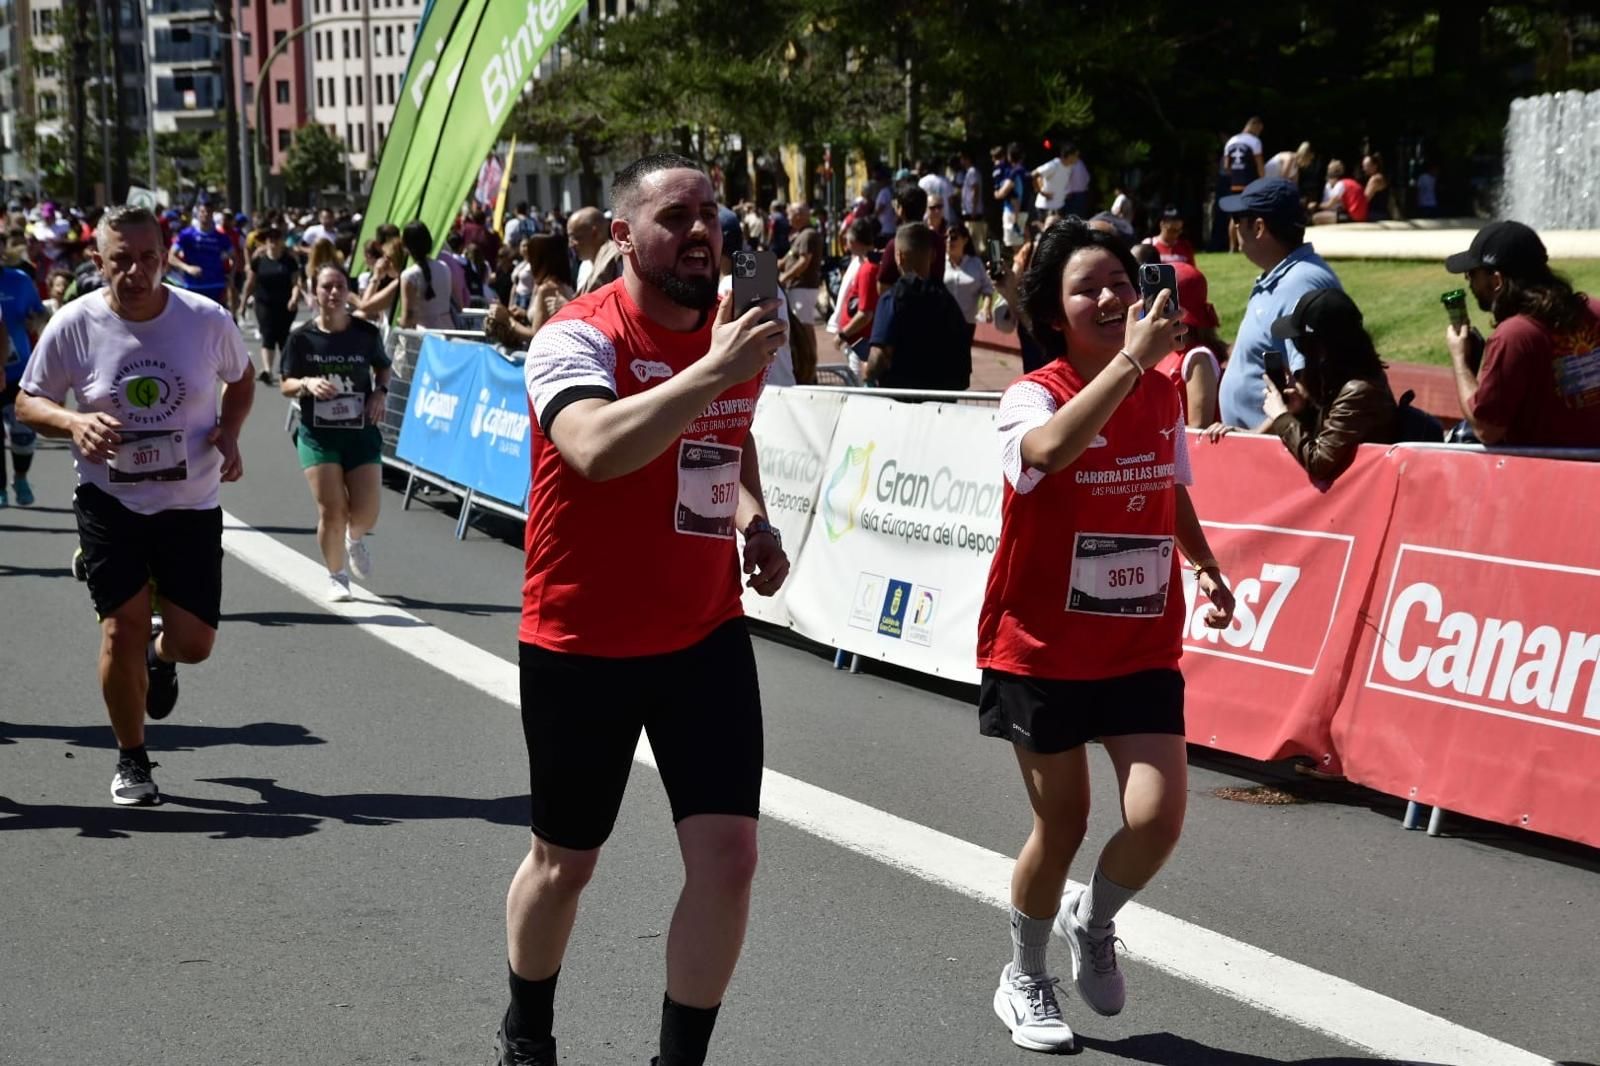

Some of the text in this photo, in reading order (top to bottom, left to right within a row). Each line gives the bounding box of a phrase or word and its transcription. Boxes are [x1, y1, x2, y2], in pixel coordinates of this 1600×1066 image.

[305, 353, 345, 363] GRUPO
[703, 401, 720, 417] LAS
[709, 417, 726, 431] GRAN
[132, 449, 160, 466] 3077
[1115, 451, 1156, 466] Canarias7
[1075, 470, 1121, 484] CARRERA
[1122, 468, 1135, 482] DE
[1135, 465, 1153, 480] LAS
[711, 482, 735, 505] 3677
[1092, 486, 1105, 496] LAS
[1105, 484, 1131, 495] PALMAS
[1131, 483, 1140, 493] DE
[770, 486, 810, 514] Deporte
[861, 507, 878, 531] Isla
[881, 512, 930, 544] Europea
[932, 518, 954, 546] del
[1108, 566, 1145, 588] 3676
